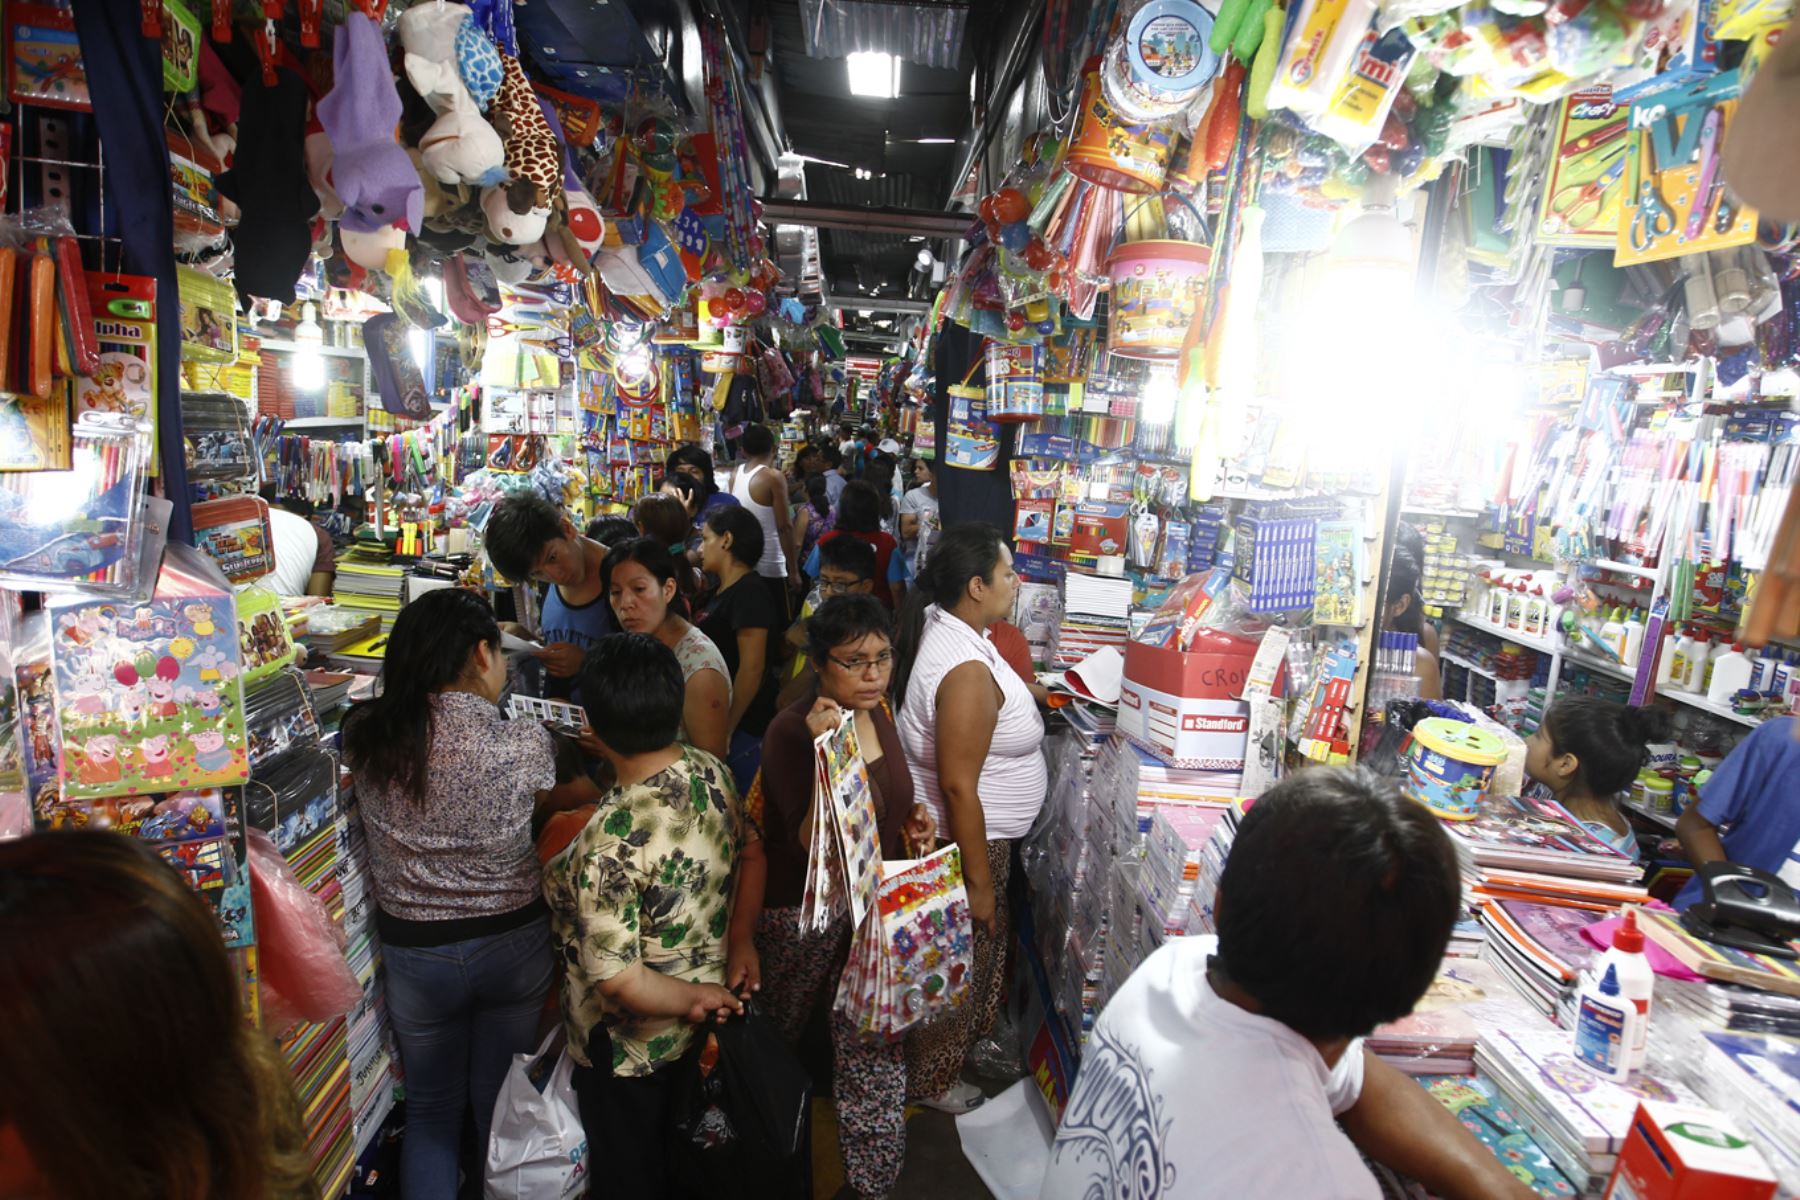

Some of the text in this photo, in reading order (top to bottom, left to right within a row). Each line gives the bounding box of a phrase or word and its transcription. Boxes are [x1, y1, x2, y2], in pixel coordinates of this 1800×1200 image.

[1569, 102, 1617, 119] Craft
[95, 320, 141, 337] lpha
[1195, 716, 1244, 731] Standford
